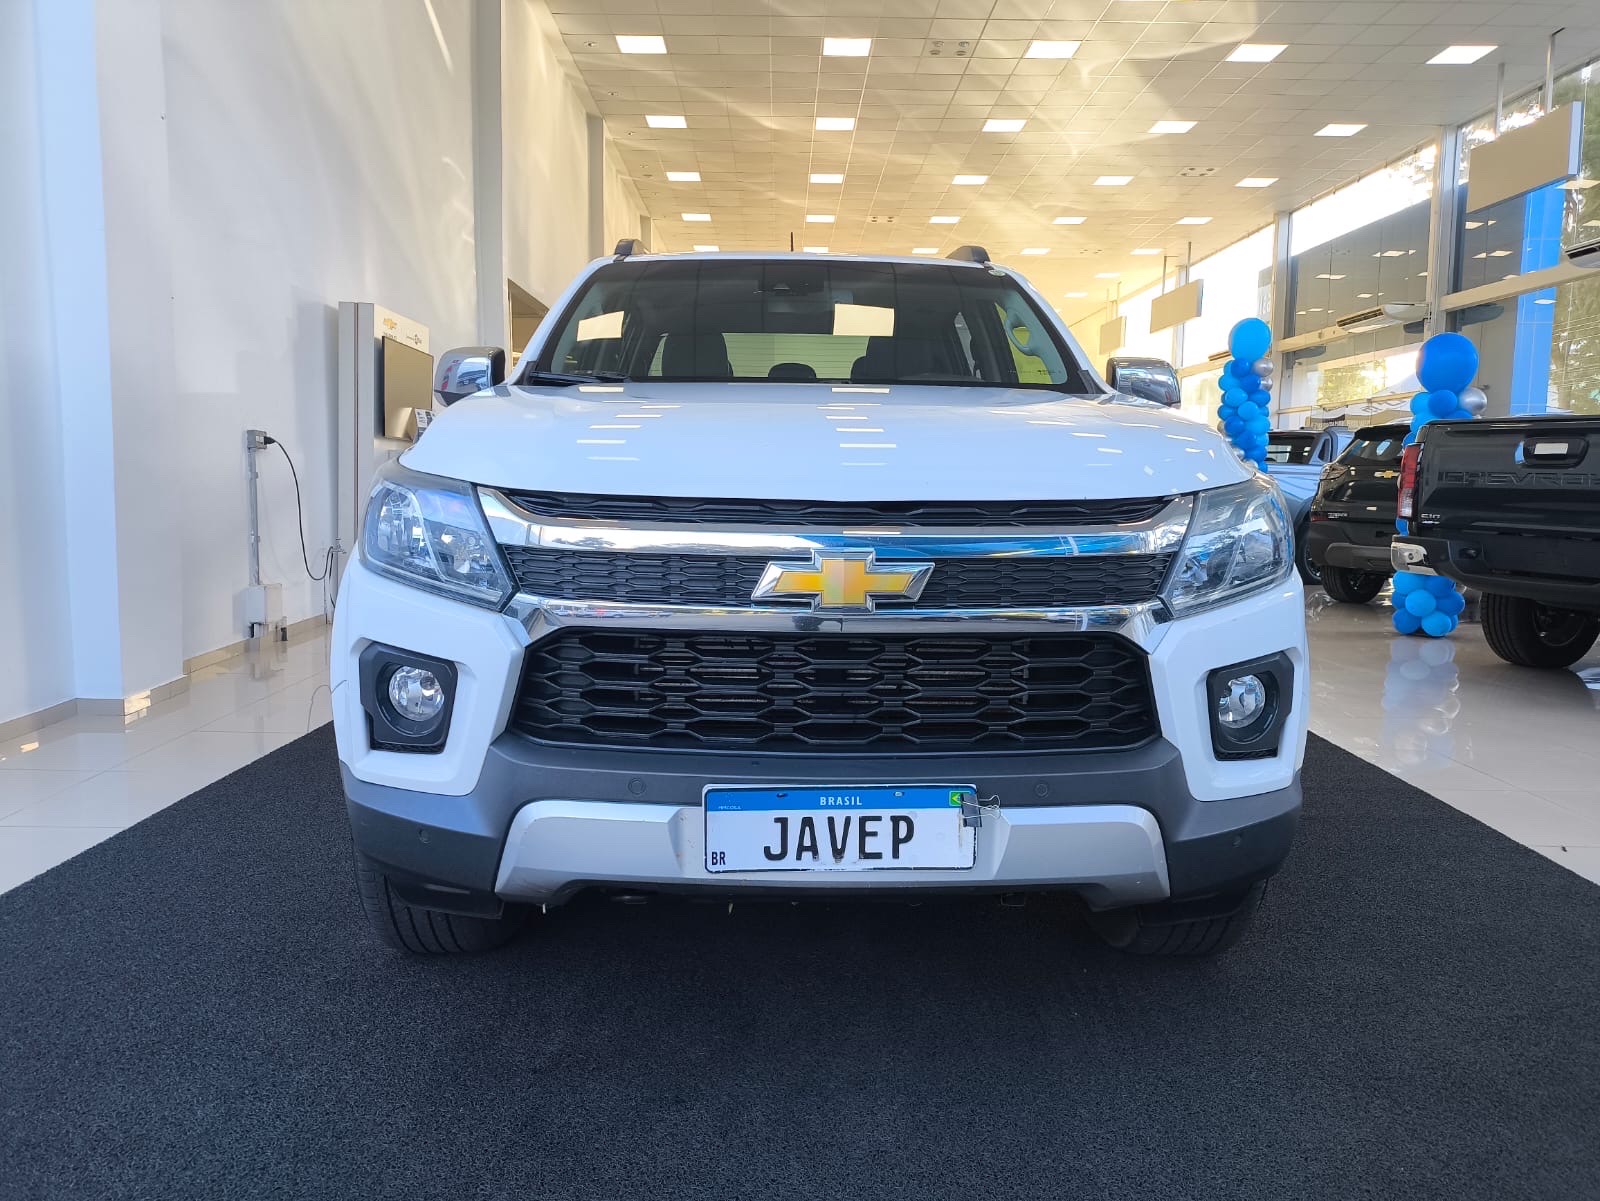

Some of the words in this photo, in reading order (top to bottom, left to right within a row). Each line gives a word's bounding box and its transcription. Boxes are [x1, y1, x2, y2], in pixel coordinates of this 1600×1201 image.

[819, 796, 863, 806] BRASIL
[763, 815, 915, 862] JAVEP
[711, 851, 726, 866] BR
